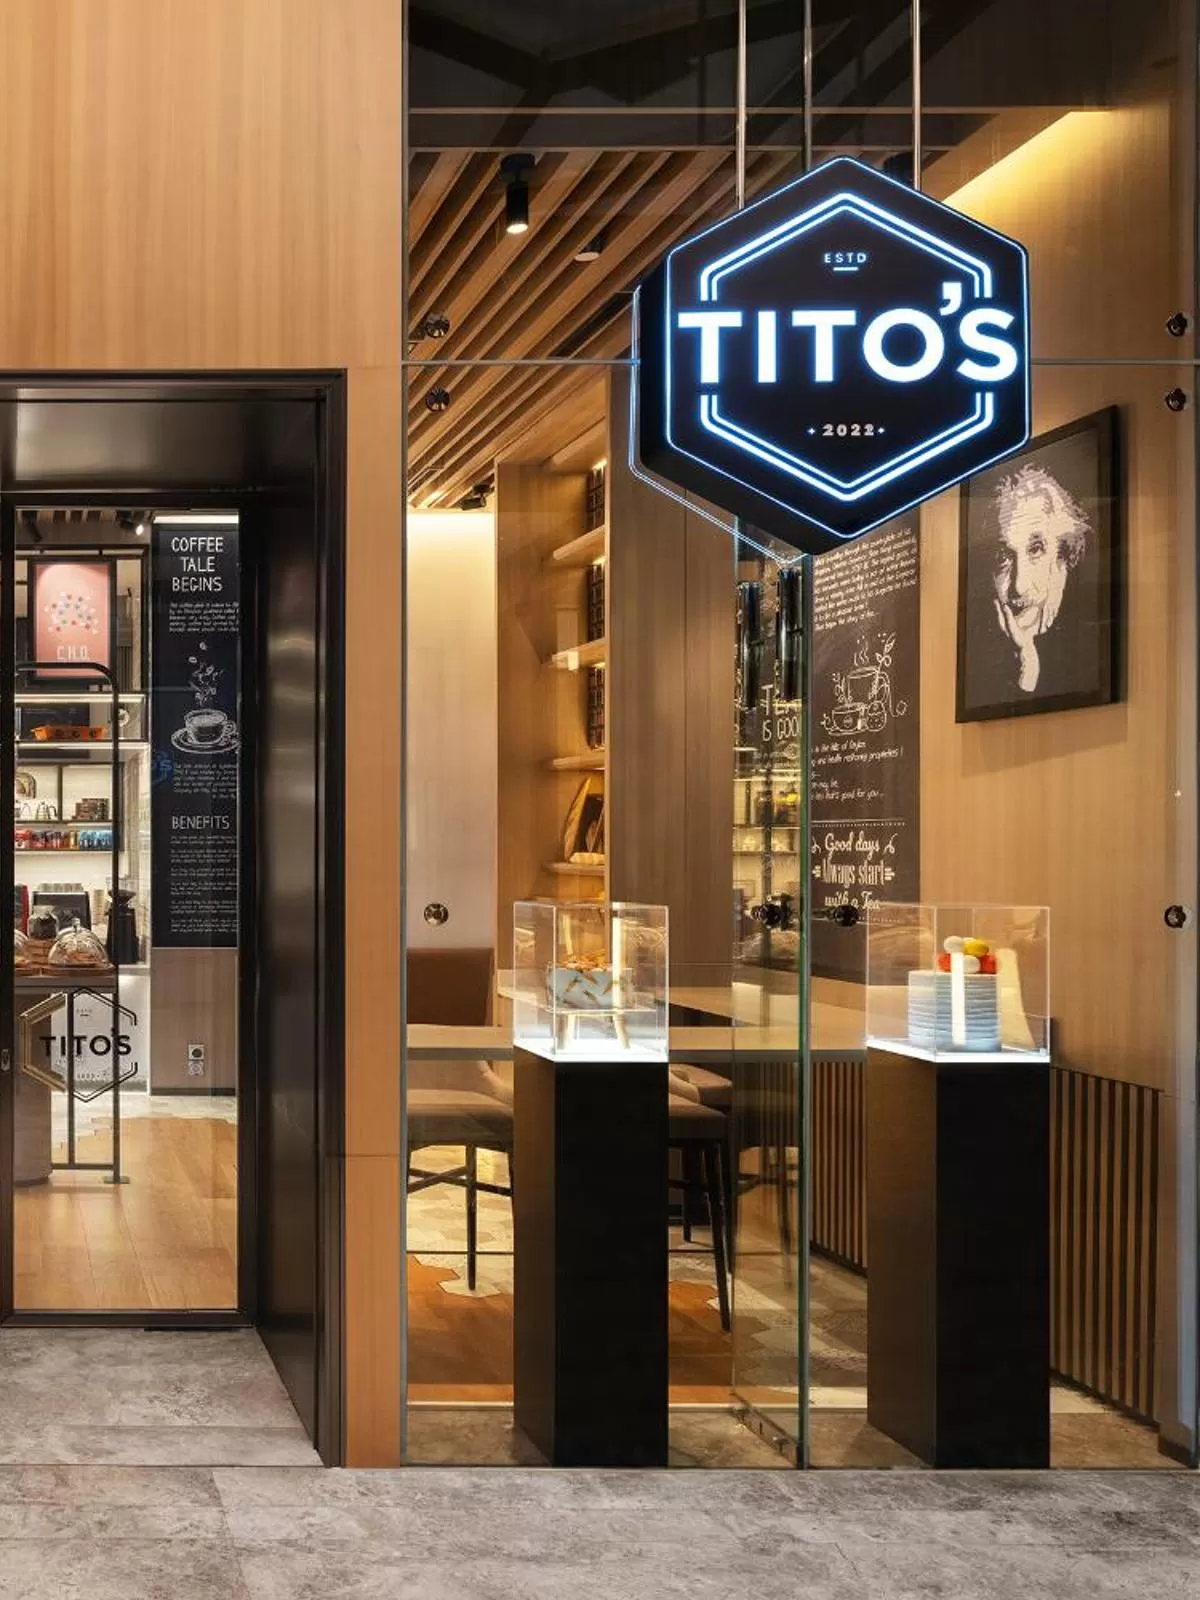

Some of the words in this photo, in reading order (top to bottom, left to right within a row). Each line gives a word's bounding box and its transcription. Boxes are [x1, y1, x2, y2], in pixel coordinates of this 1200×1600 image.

[824, 252, 867, 264] ESTD
[678, 282, 1018, 383] TITO'S
[822, 424, 875, 436] 2022
[171, 537, 224, 552] COFFEE
[180, 556, 215, 572] TALE
[172, 577, 223, 592] BEGINS
[172, 816, 230, 829] BENEFITS
[825, 832, 855, 860] Good
[855, 831, 880, 860] days
[858, 860, 884, 885] start
[825, 891, 849, 907] with
[851, 898, 859, 909] a
[39, 1027, 132, 1056] TITO'S
